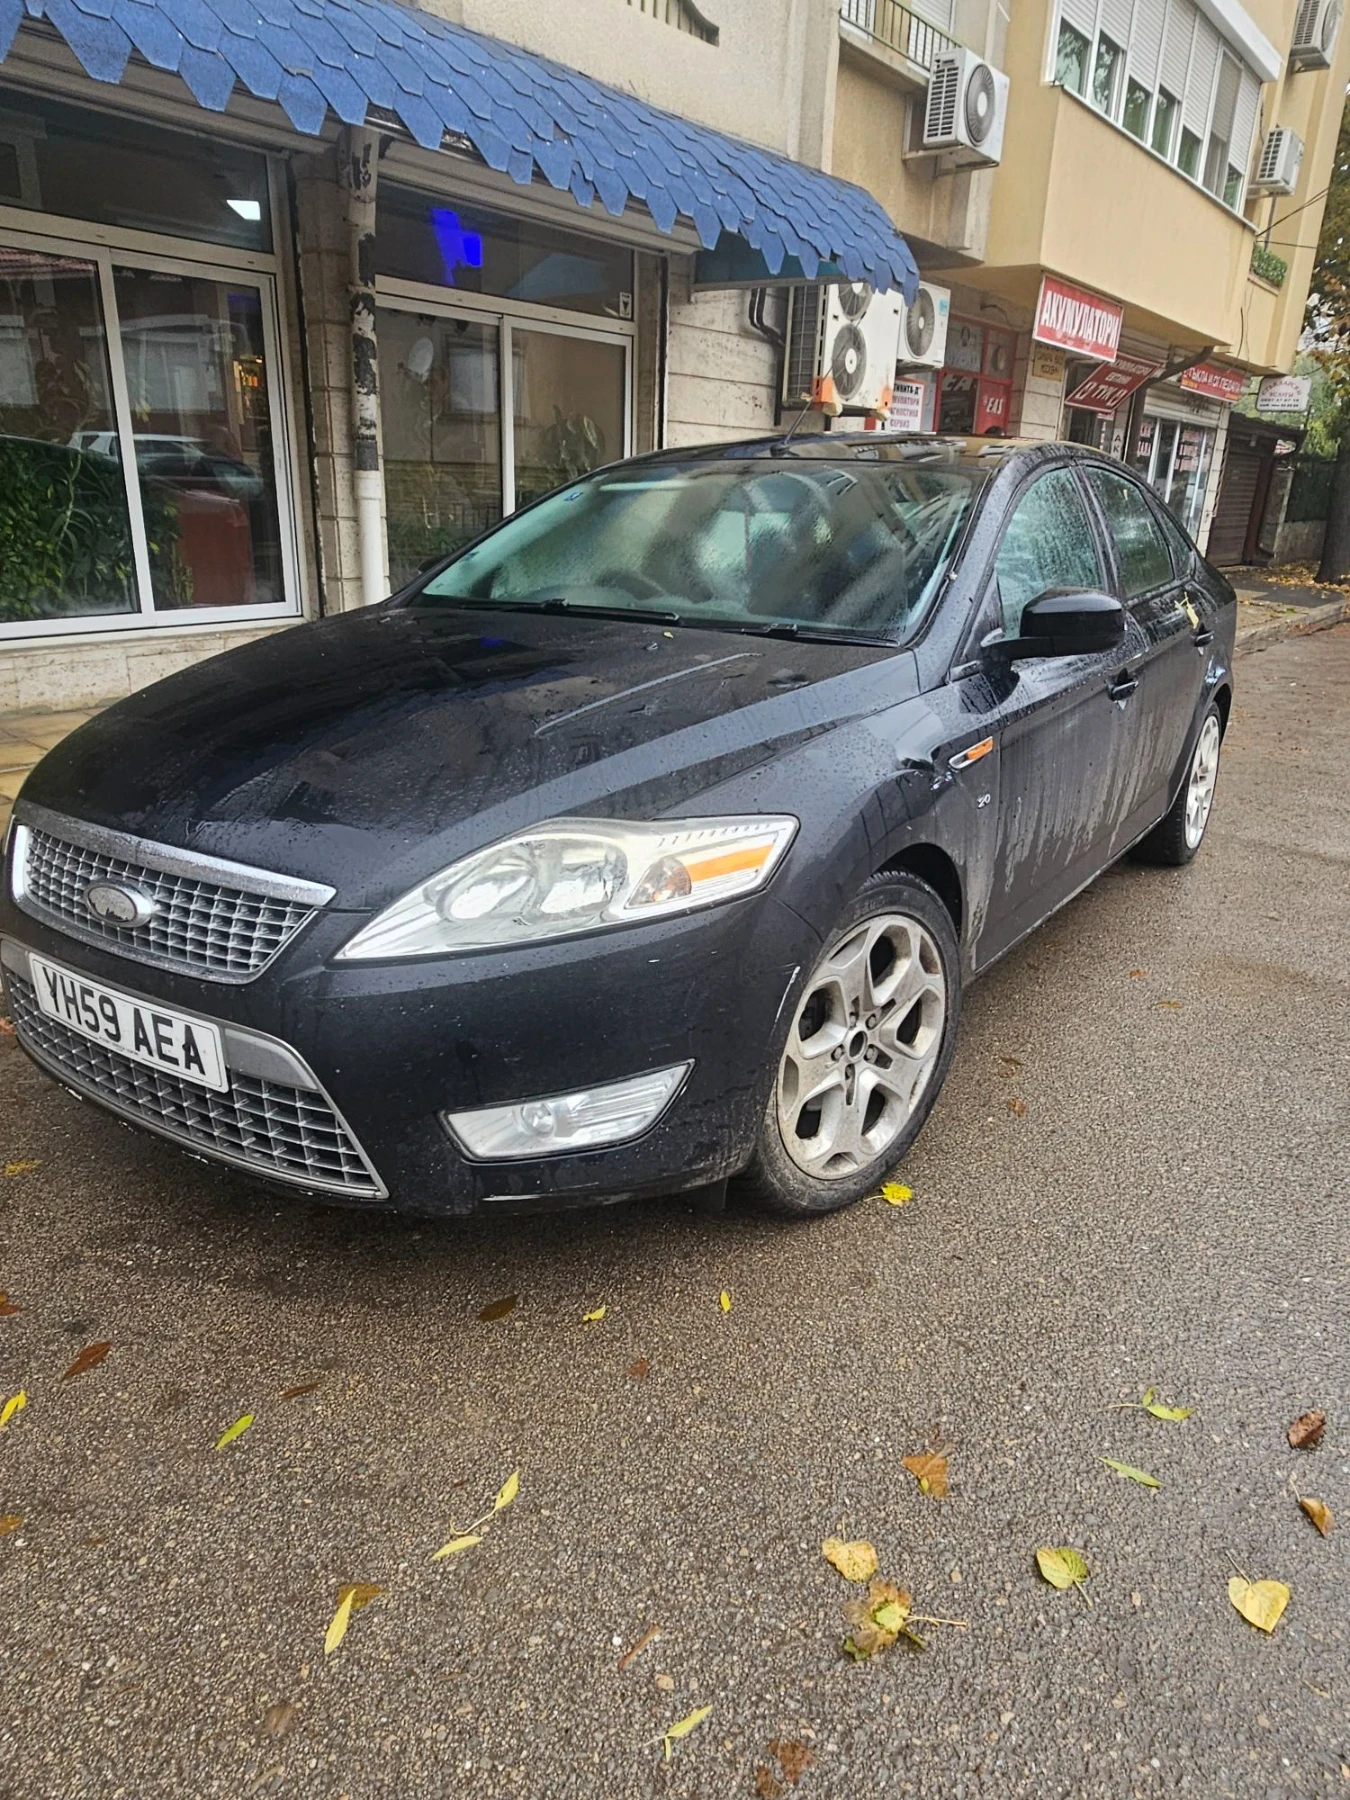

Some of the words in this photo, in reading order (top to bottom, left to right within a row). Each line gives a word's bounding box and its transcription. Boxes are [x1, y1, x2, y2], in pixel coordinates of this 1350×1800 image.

[1040, 290, 1119, 348] АКУМУЛАТОРИ
[42, 966, 121, 1043] YH59
[133, 1007, 207, 1076] AEA
